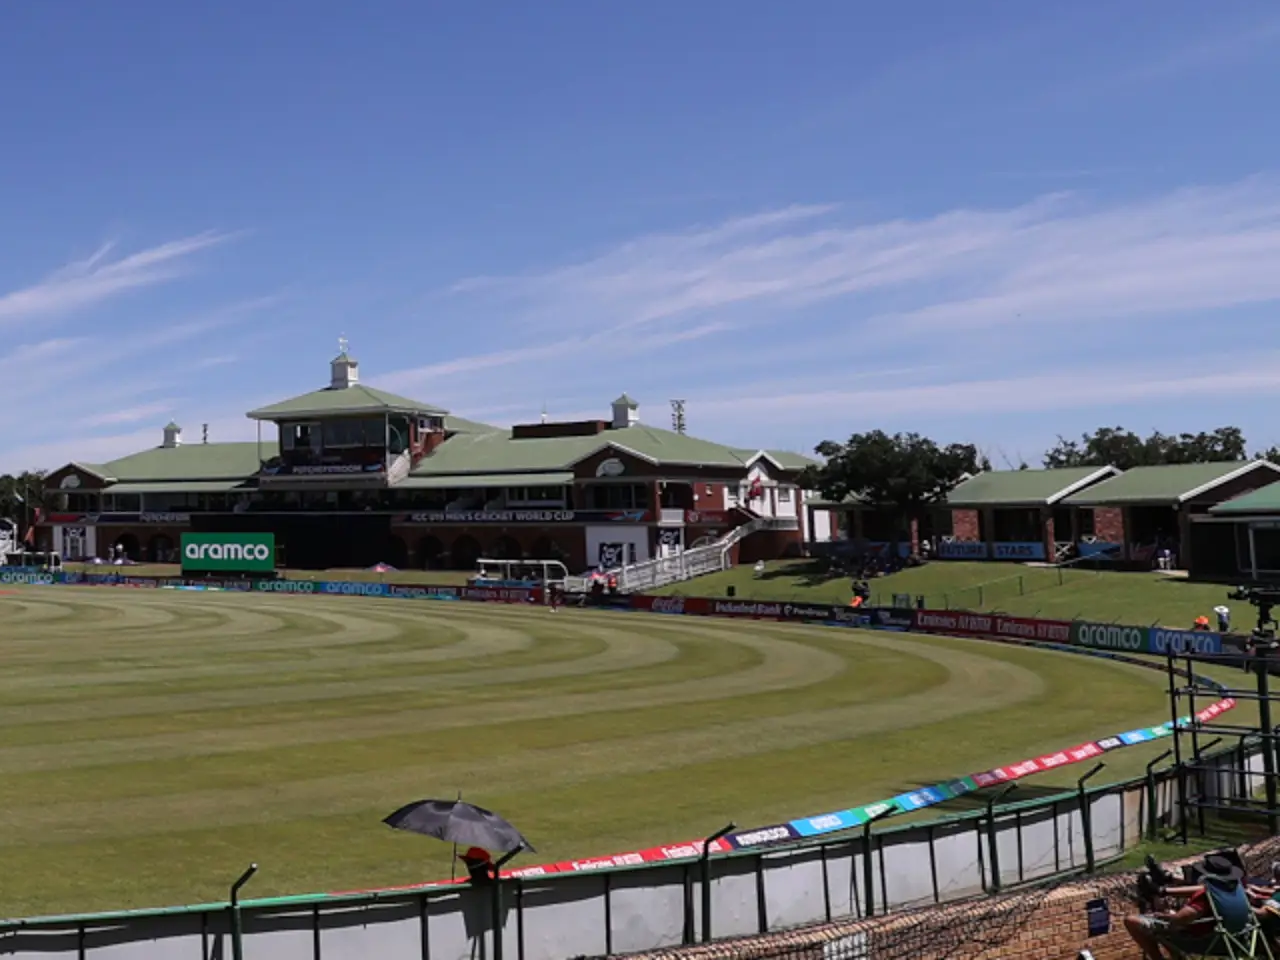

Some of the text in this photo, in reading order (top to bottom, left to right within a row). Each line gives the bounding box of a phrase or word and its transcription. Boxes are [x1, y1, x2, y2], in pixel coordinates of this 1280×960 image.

[185, 543, 270, 561] aramco
[1, 572, 54, 584] aramco
[258, 581, 315, 593] aramco
[326, 582, 383, 596] aramco
[1078, 624, 1142, 649] aramco
